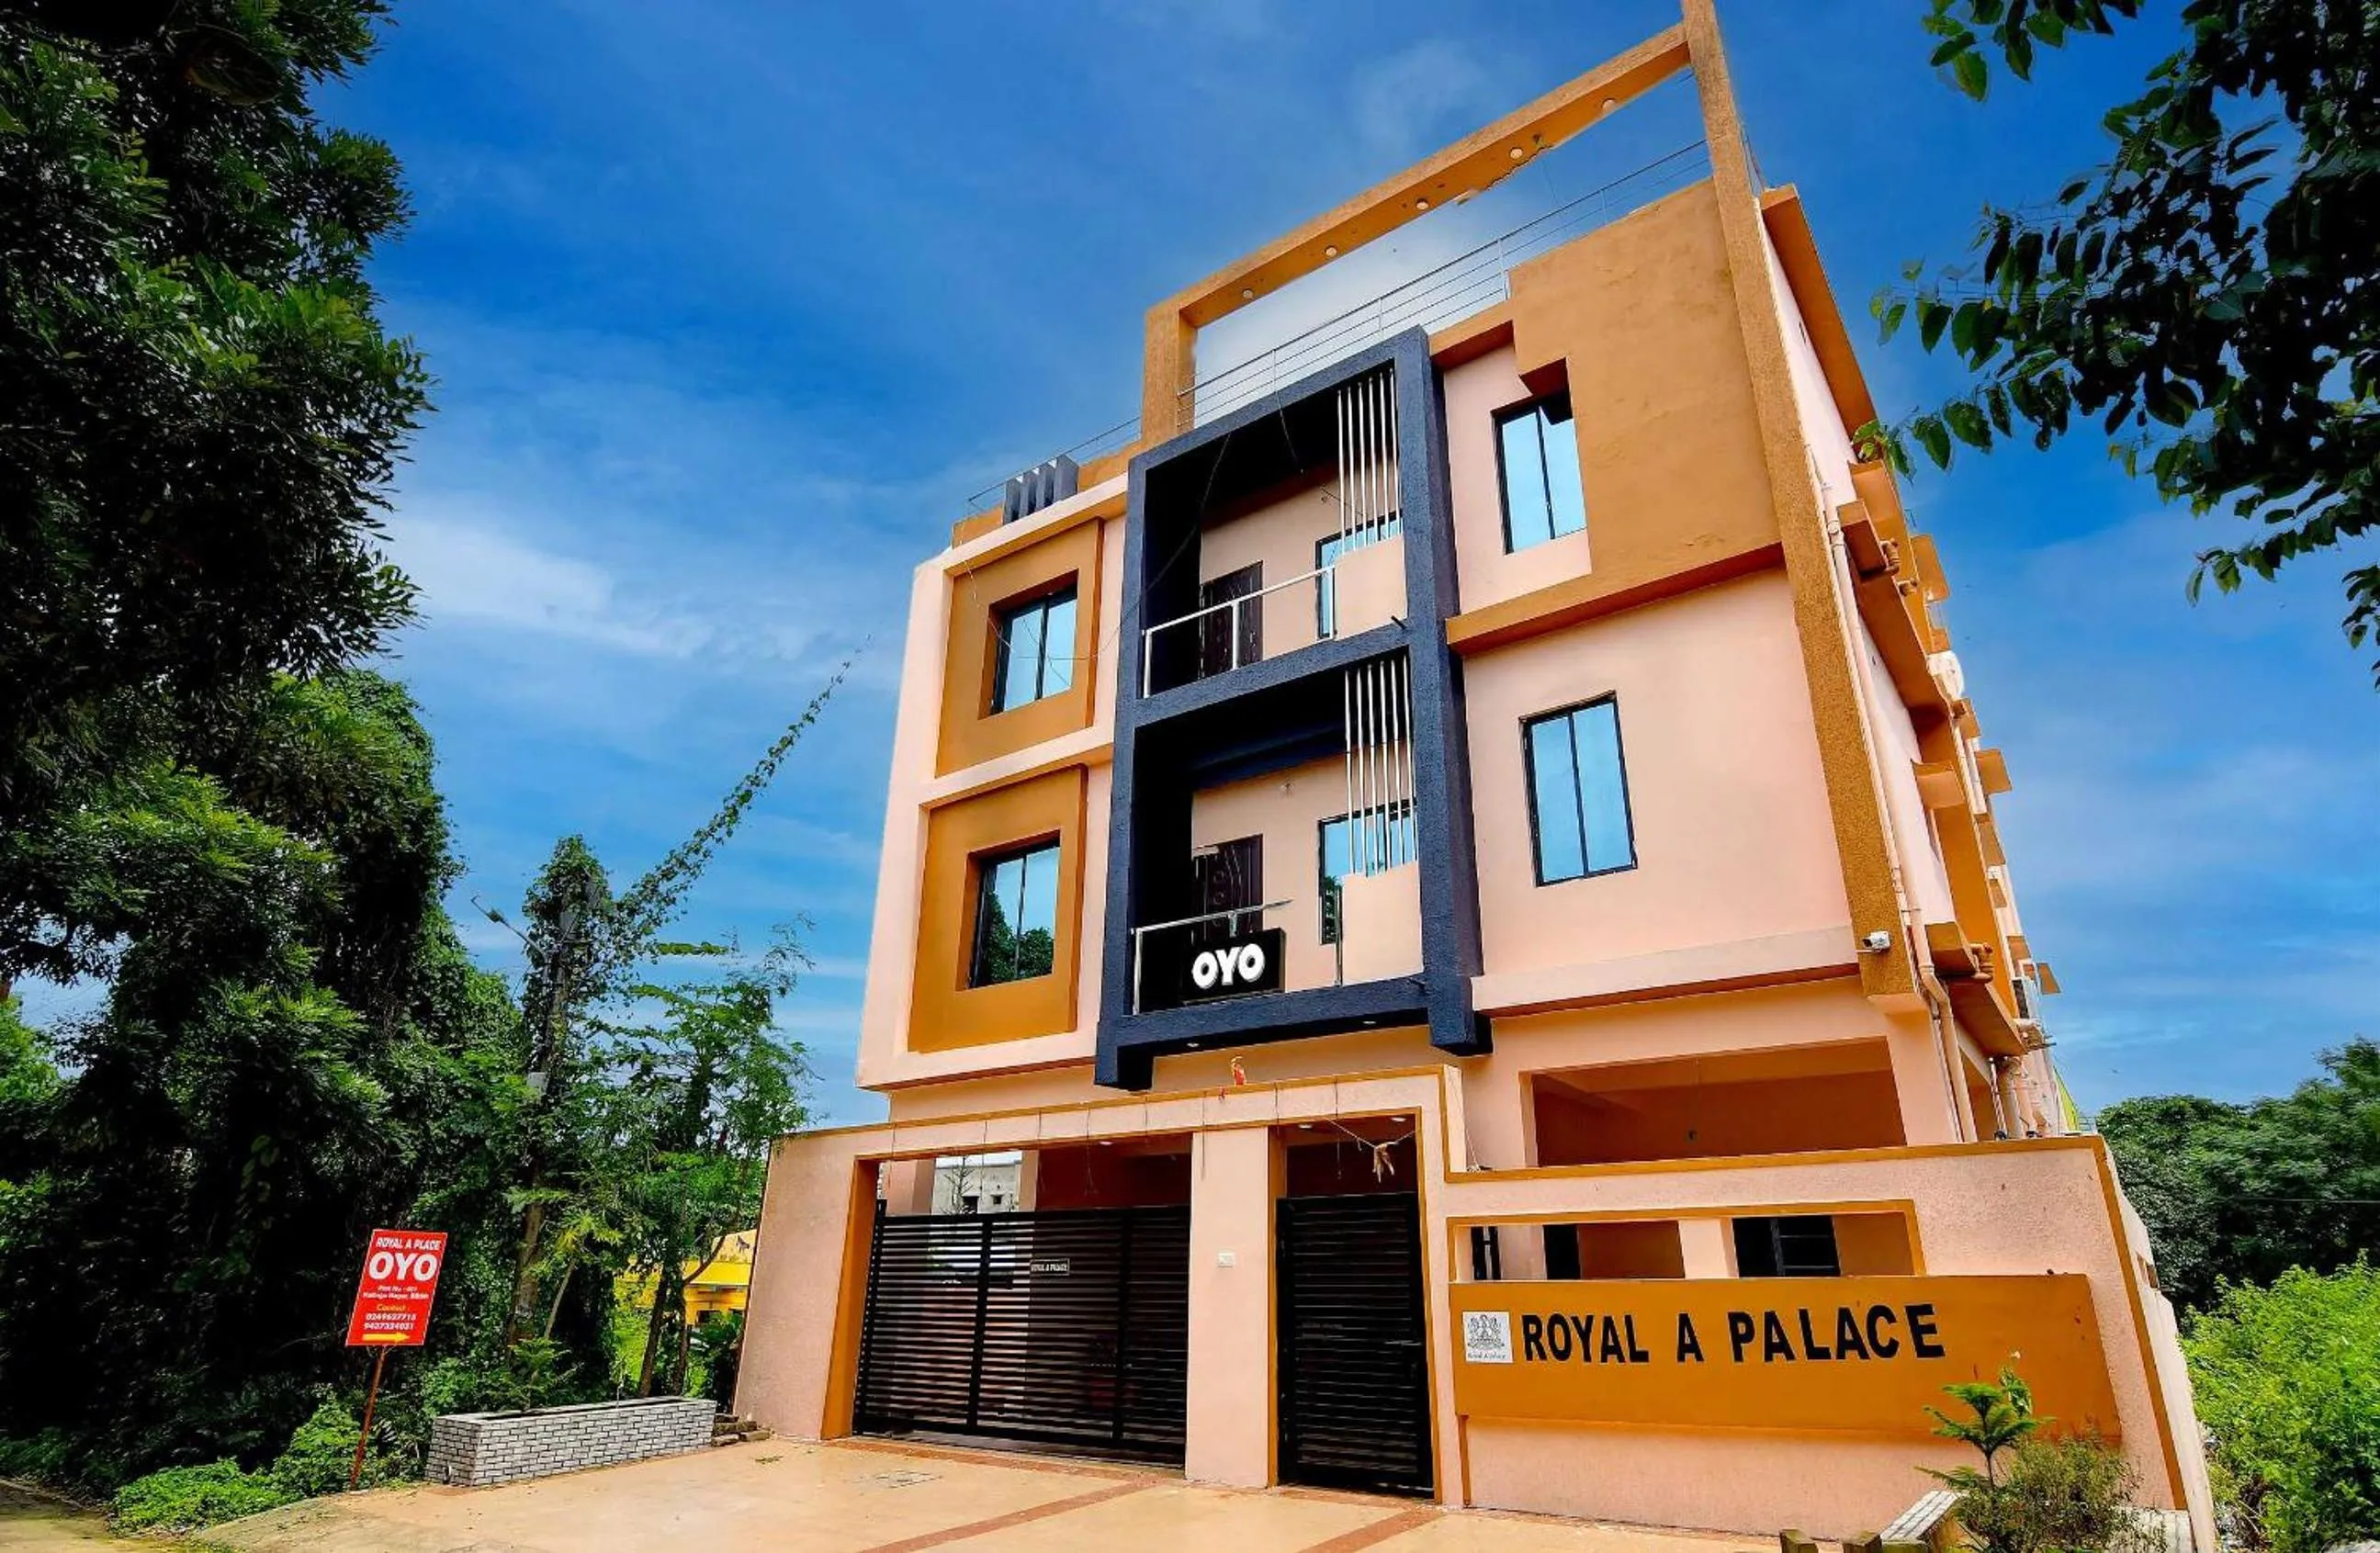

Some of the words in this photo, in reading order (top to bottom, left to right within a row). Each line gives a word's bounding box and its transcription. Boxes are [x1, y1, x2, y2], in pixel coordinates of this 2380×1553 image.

[1191, 943, 1265, 989] OYO
[376, 1237, 403, 1248] ROYAL
[404, 1238, 412, 1250] A
[369, 1251, 437, 1282] OYO
[1521, 1313, 1650, 1364] ROYAL
[1676, 1312, 1704, 1364] A
[1727, 1303, 1946, 1364] PALACE
